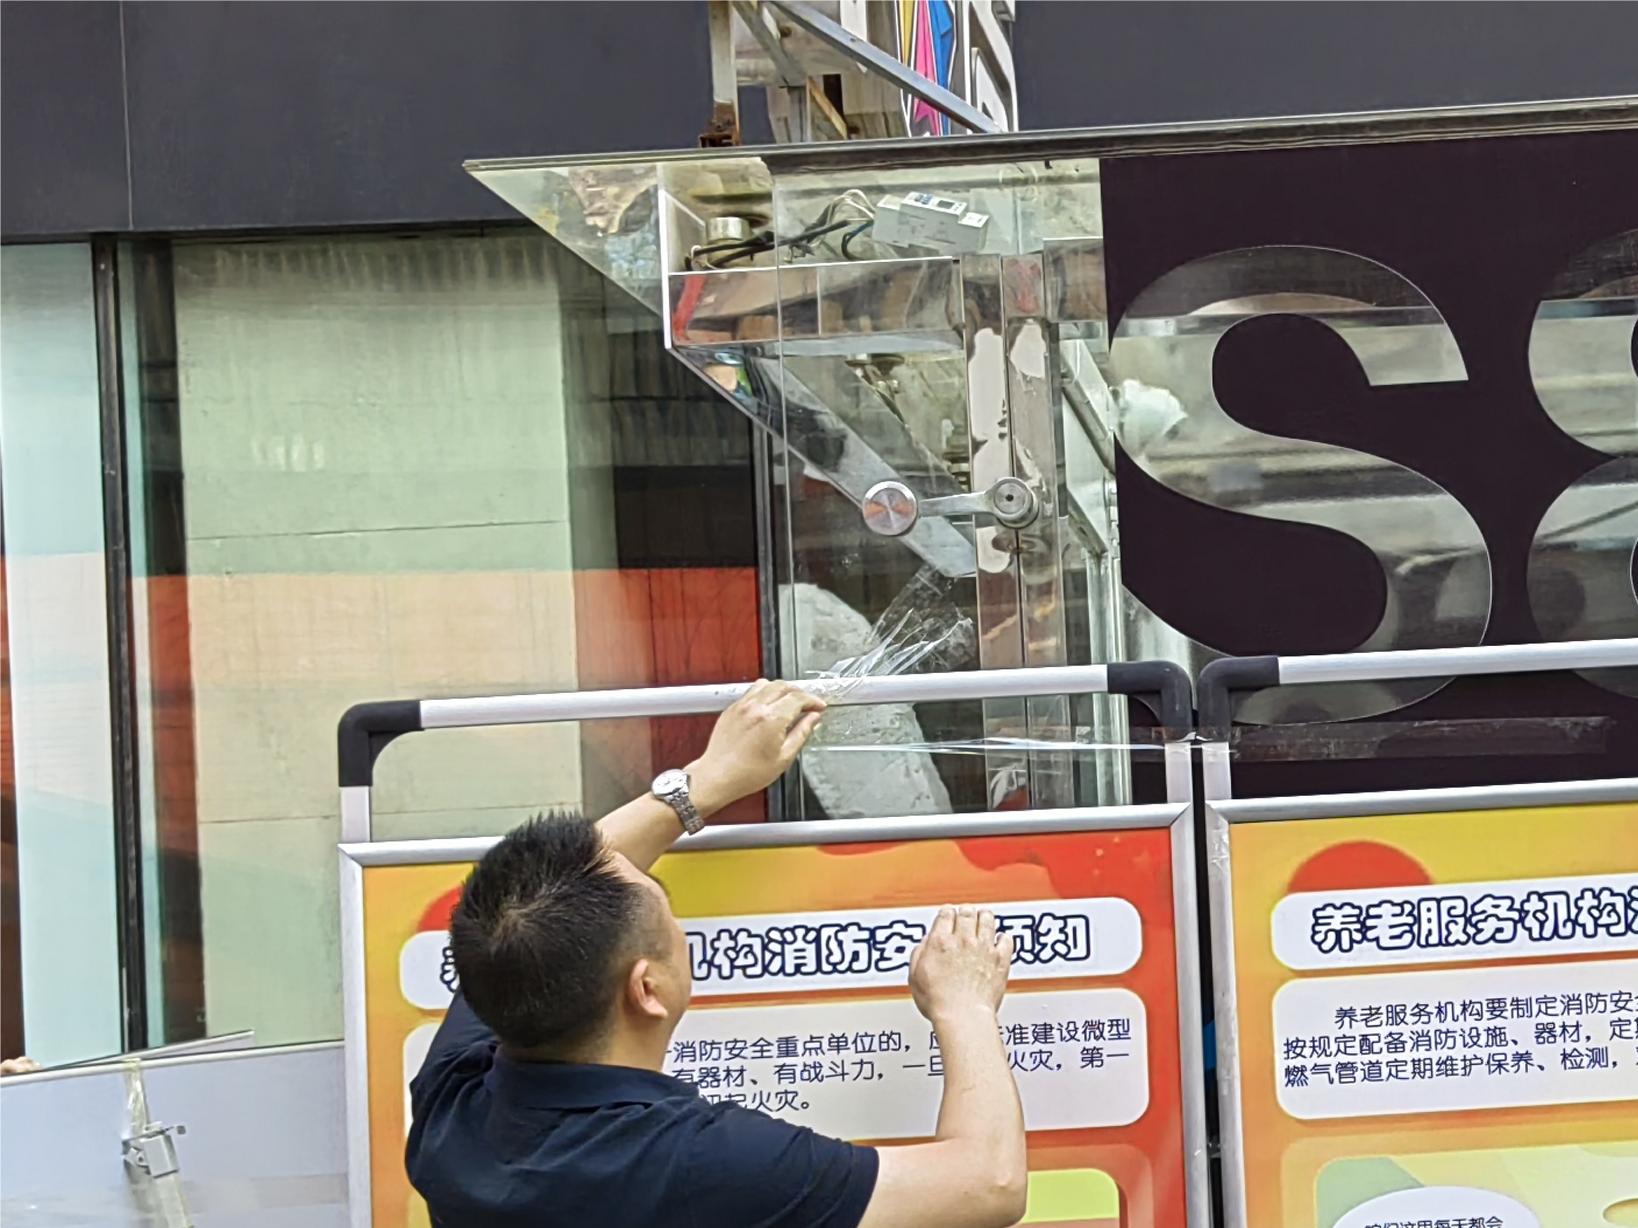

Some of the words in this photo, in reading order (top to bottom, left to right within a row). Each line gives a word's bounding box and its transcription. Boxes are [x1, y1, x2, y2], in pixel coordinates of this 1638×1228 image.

[685, 912, 1090, 982] 构消防安须知
[671, 1045, 1130, 1089] 有器材、有战斗力，一旦火灾，第一
